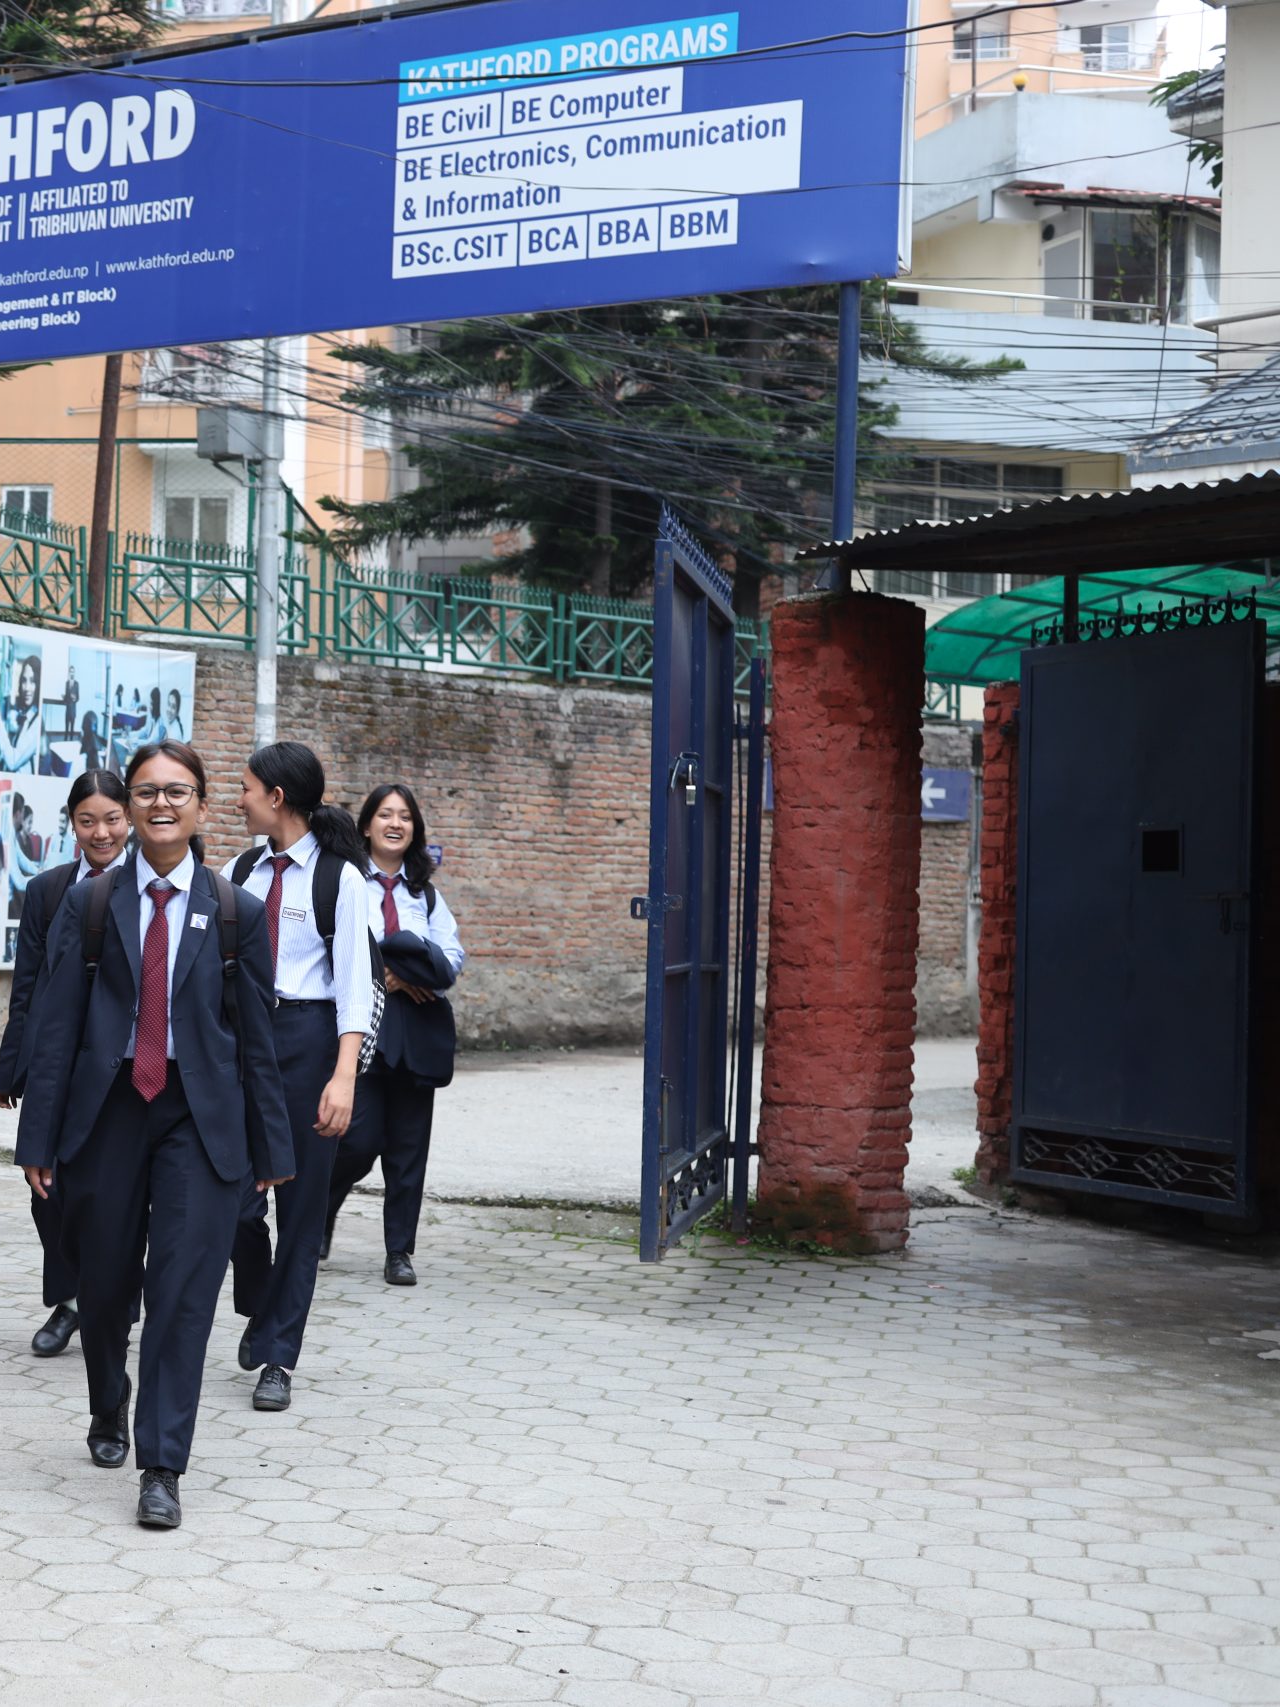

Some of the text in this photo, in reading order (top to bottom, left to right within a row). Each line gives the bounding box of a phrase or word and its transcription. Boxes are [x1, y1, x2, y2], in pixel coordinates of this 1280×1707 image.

[407, 22, 728, 96] KATHFORD PROGRAMS
[405, 85, 671, 139] BE Civil BE Computer
[404, 114, 787, 183] BE Electronics, Communication
[30, 179, 129, 213] AFFILIATED TO
[402, 181, 561, 221] & Information
[30, 196, 194, 239] TRIBHUVAN UNIVERSITY
[401, 208, 728, 267] BSc.CSIT BCA BBA BBM
[105, 248, 235, 274] www.kathford.edu.np
[50, 292, 60, 306] &
[62, 291, 74, 305] IT
[76, 286, 117, 304] Block)
[41, 310, 80, 327] Block)
